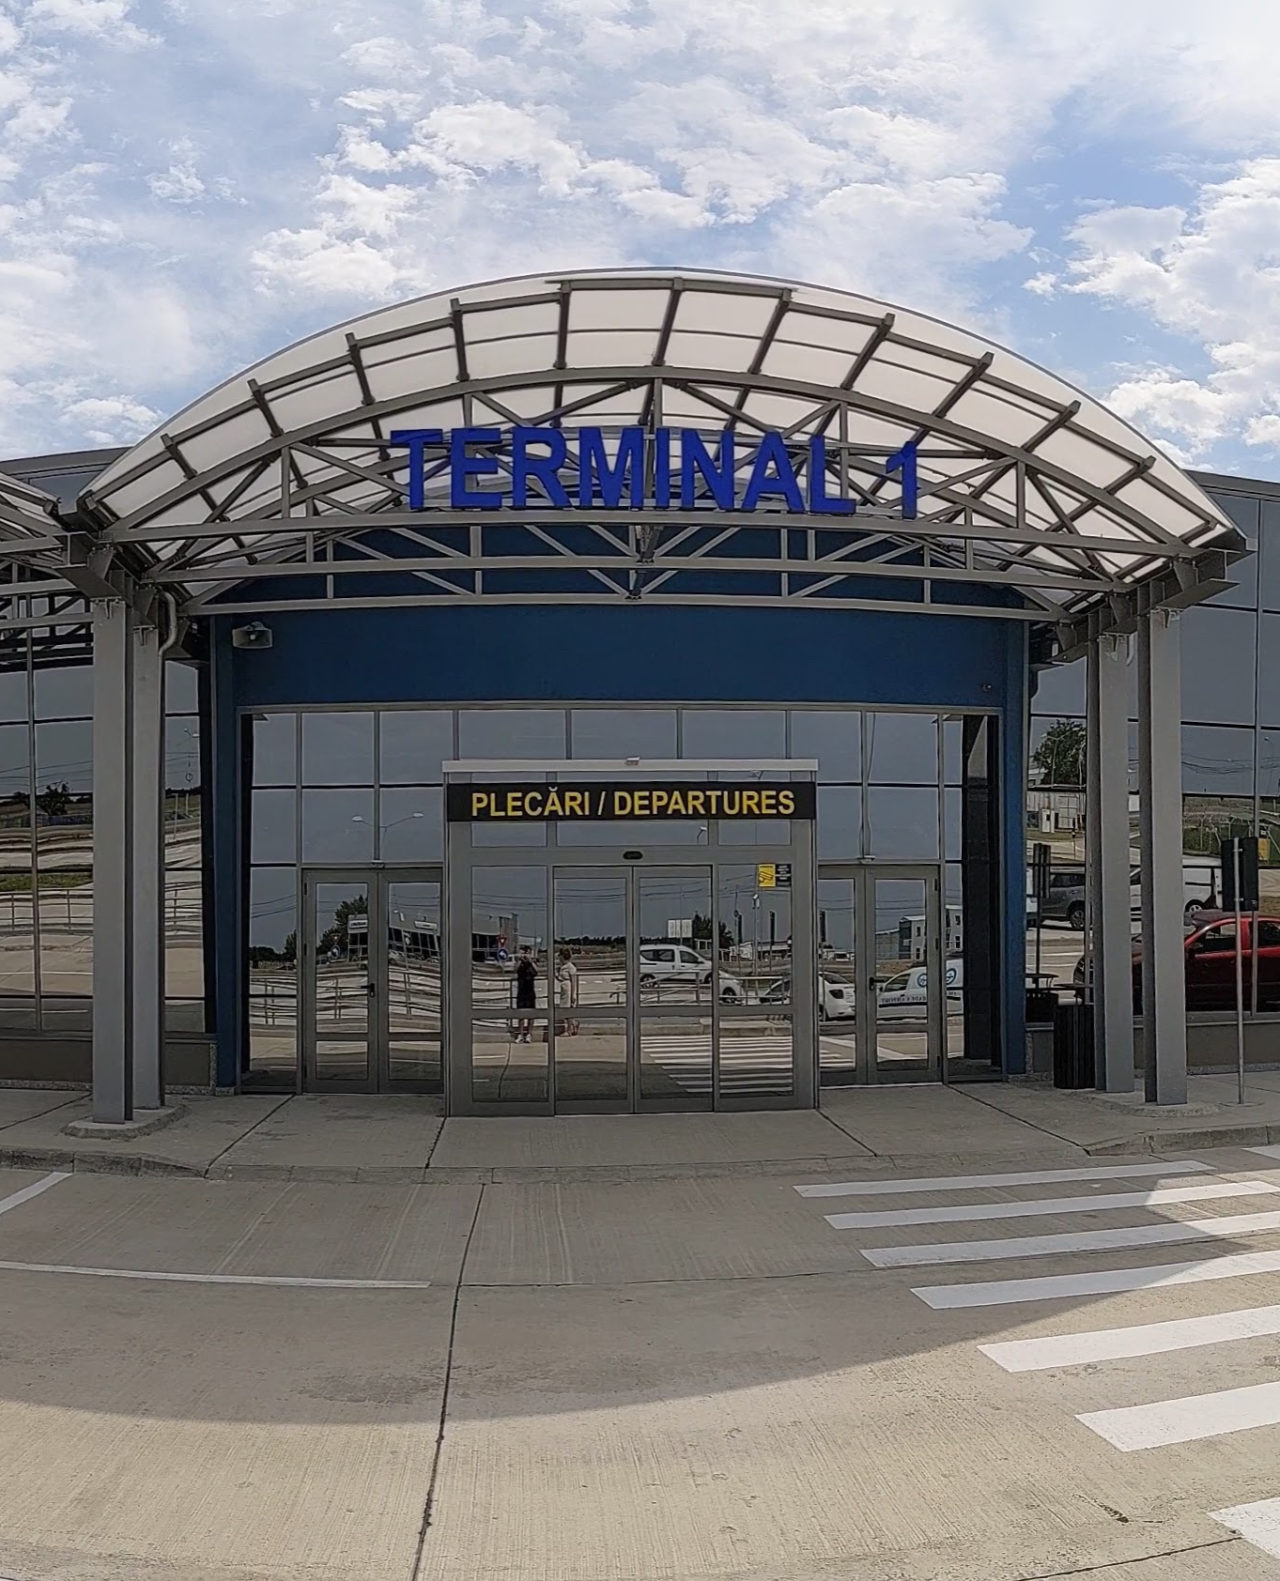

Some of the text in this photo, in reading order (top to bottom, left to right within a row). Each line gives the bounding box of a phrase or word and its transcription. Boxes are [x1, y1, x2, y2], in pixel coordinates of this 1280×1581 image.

[390, 426, 918, 520] TERMINAL 1
[472, 786, 590, 817] PLECĂRI
[613, 790, 795, 816] DEPARTURES
